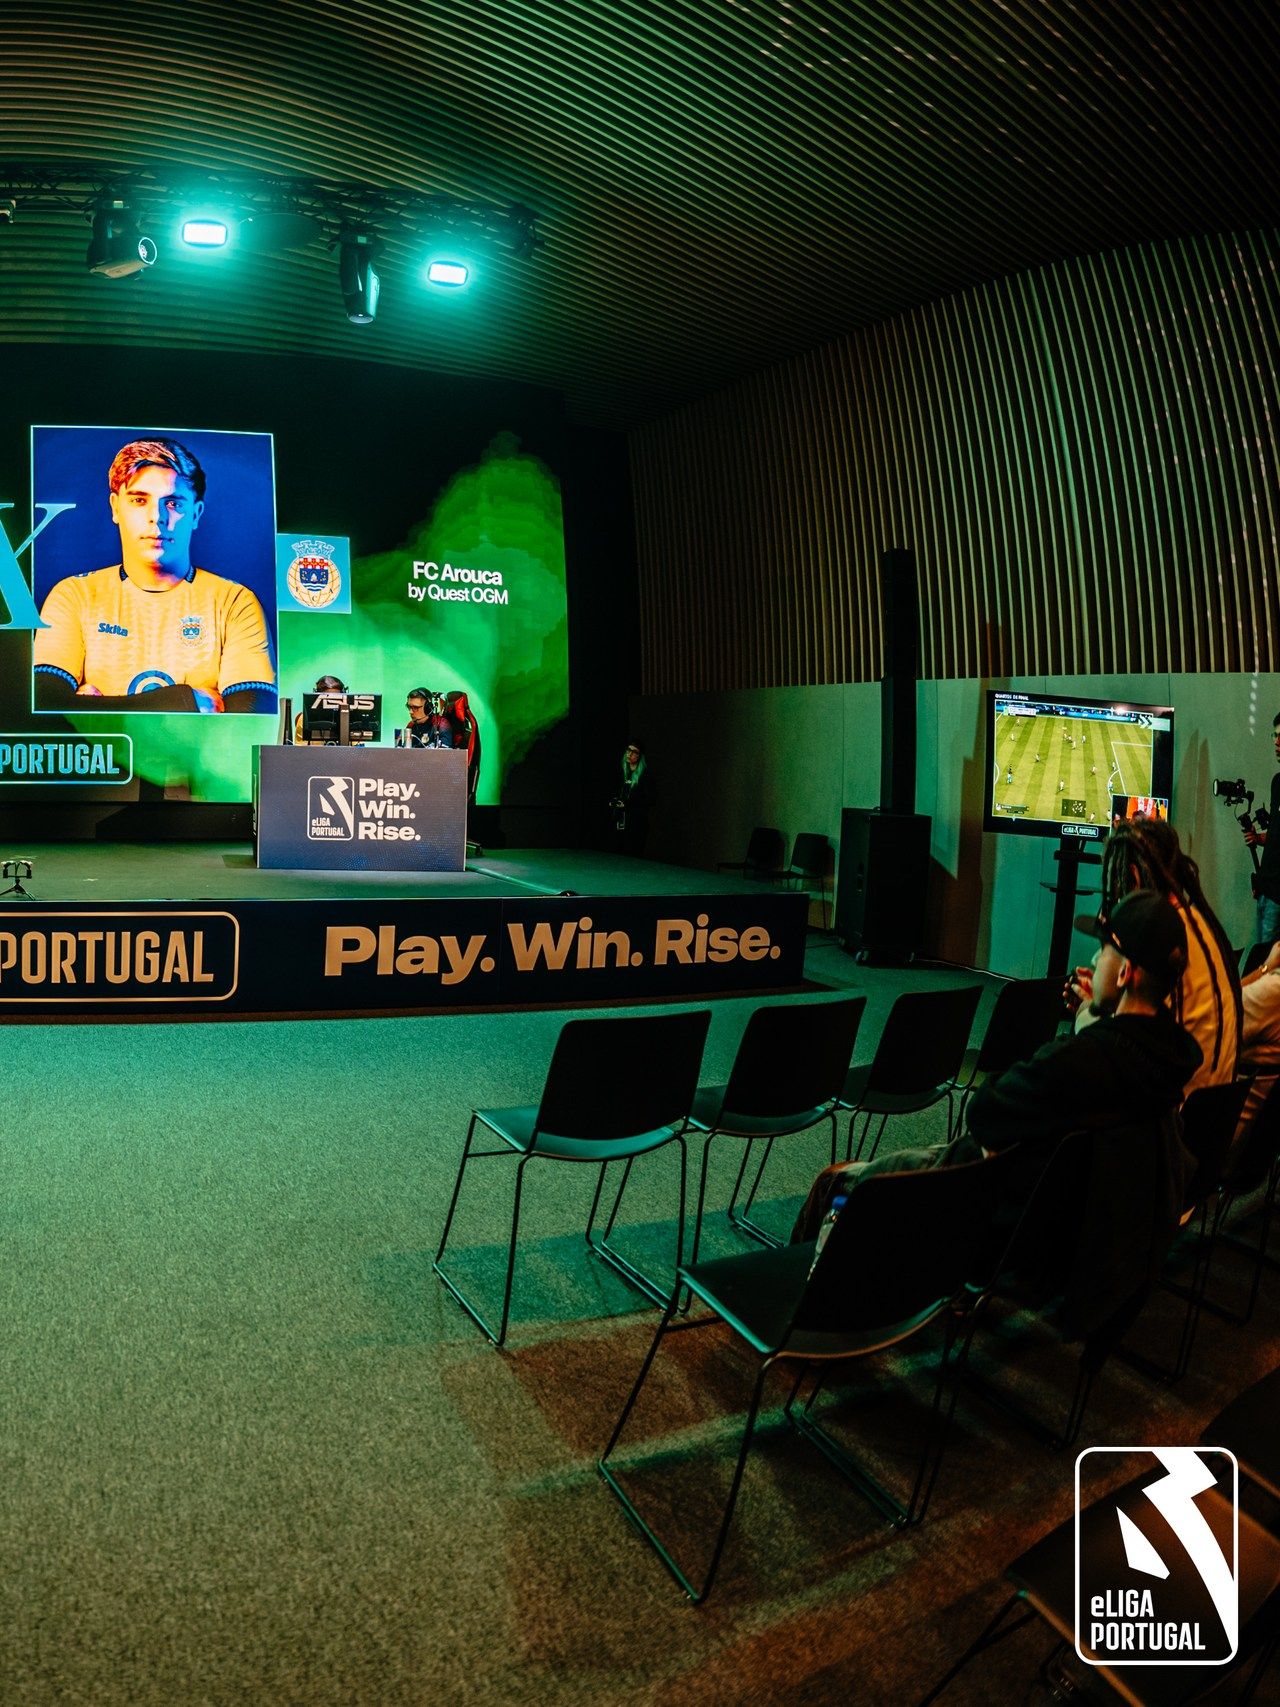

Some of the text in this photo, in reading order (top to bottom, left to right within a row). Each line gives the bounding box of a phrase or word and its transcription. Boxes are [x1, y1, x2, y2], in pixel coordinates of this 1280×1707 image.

[413, 561, 503, 585] FC Arouca
[408, 582, 509, 605] by Quest OGM
[359, 778, 420, 801] Play.
[359, 799, 416, 819] Win.
[311, 817, 331, 827] eLIGA
[311, 826, 345, 837] PORTUGAL
[358, 820, 421, 841] Rise.
[324, 913, 781, 985] Play. Win. Rise.
